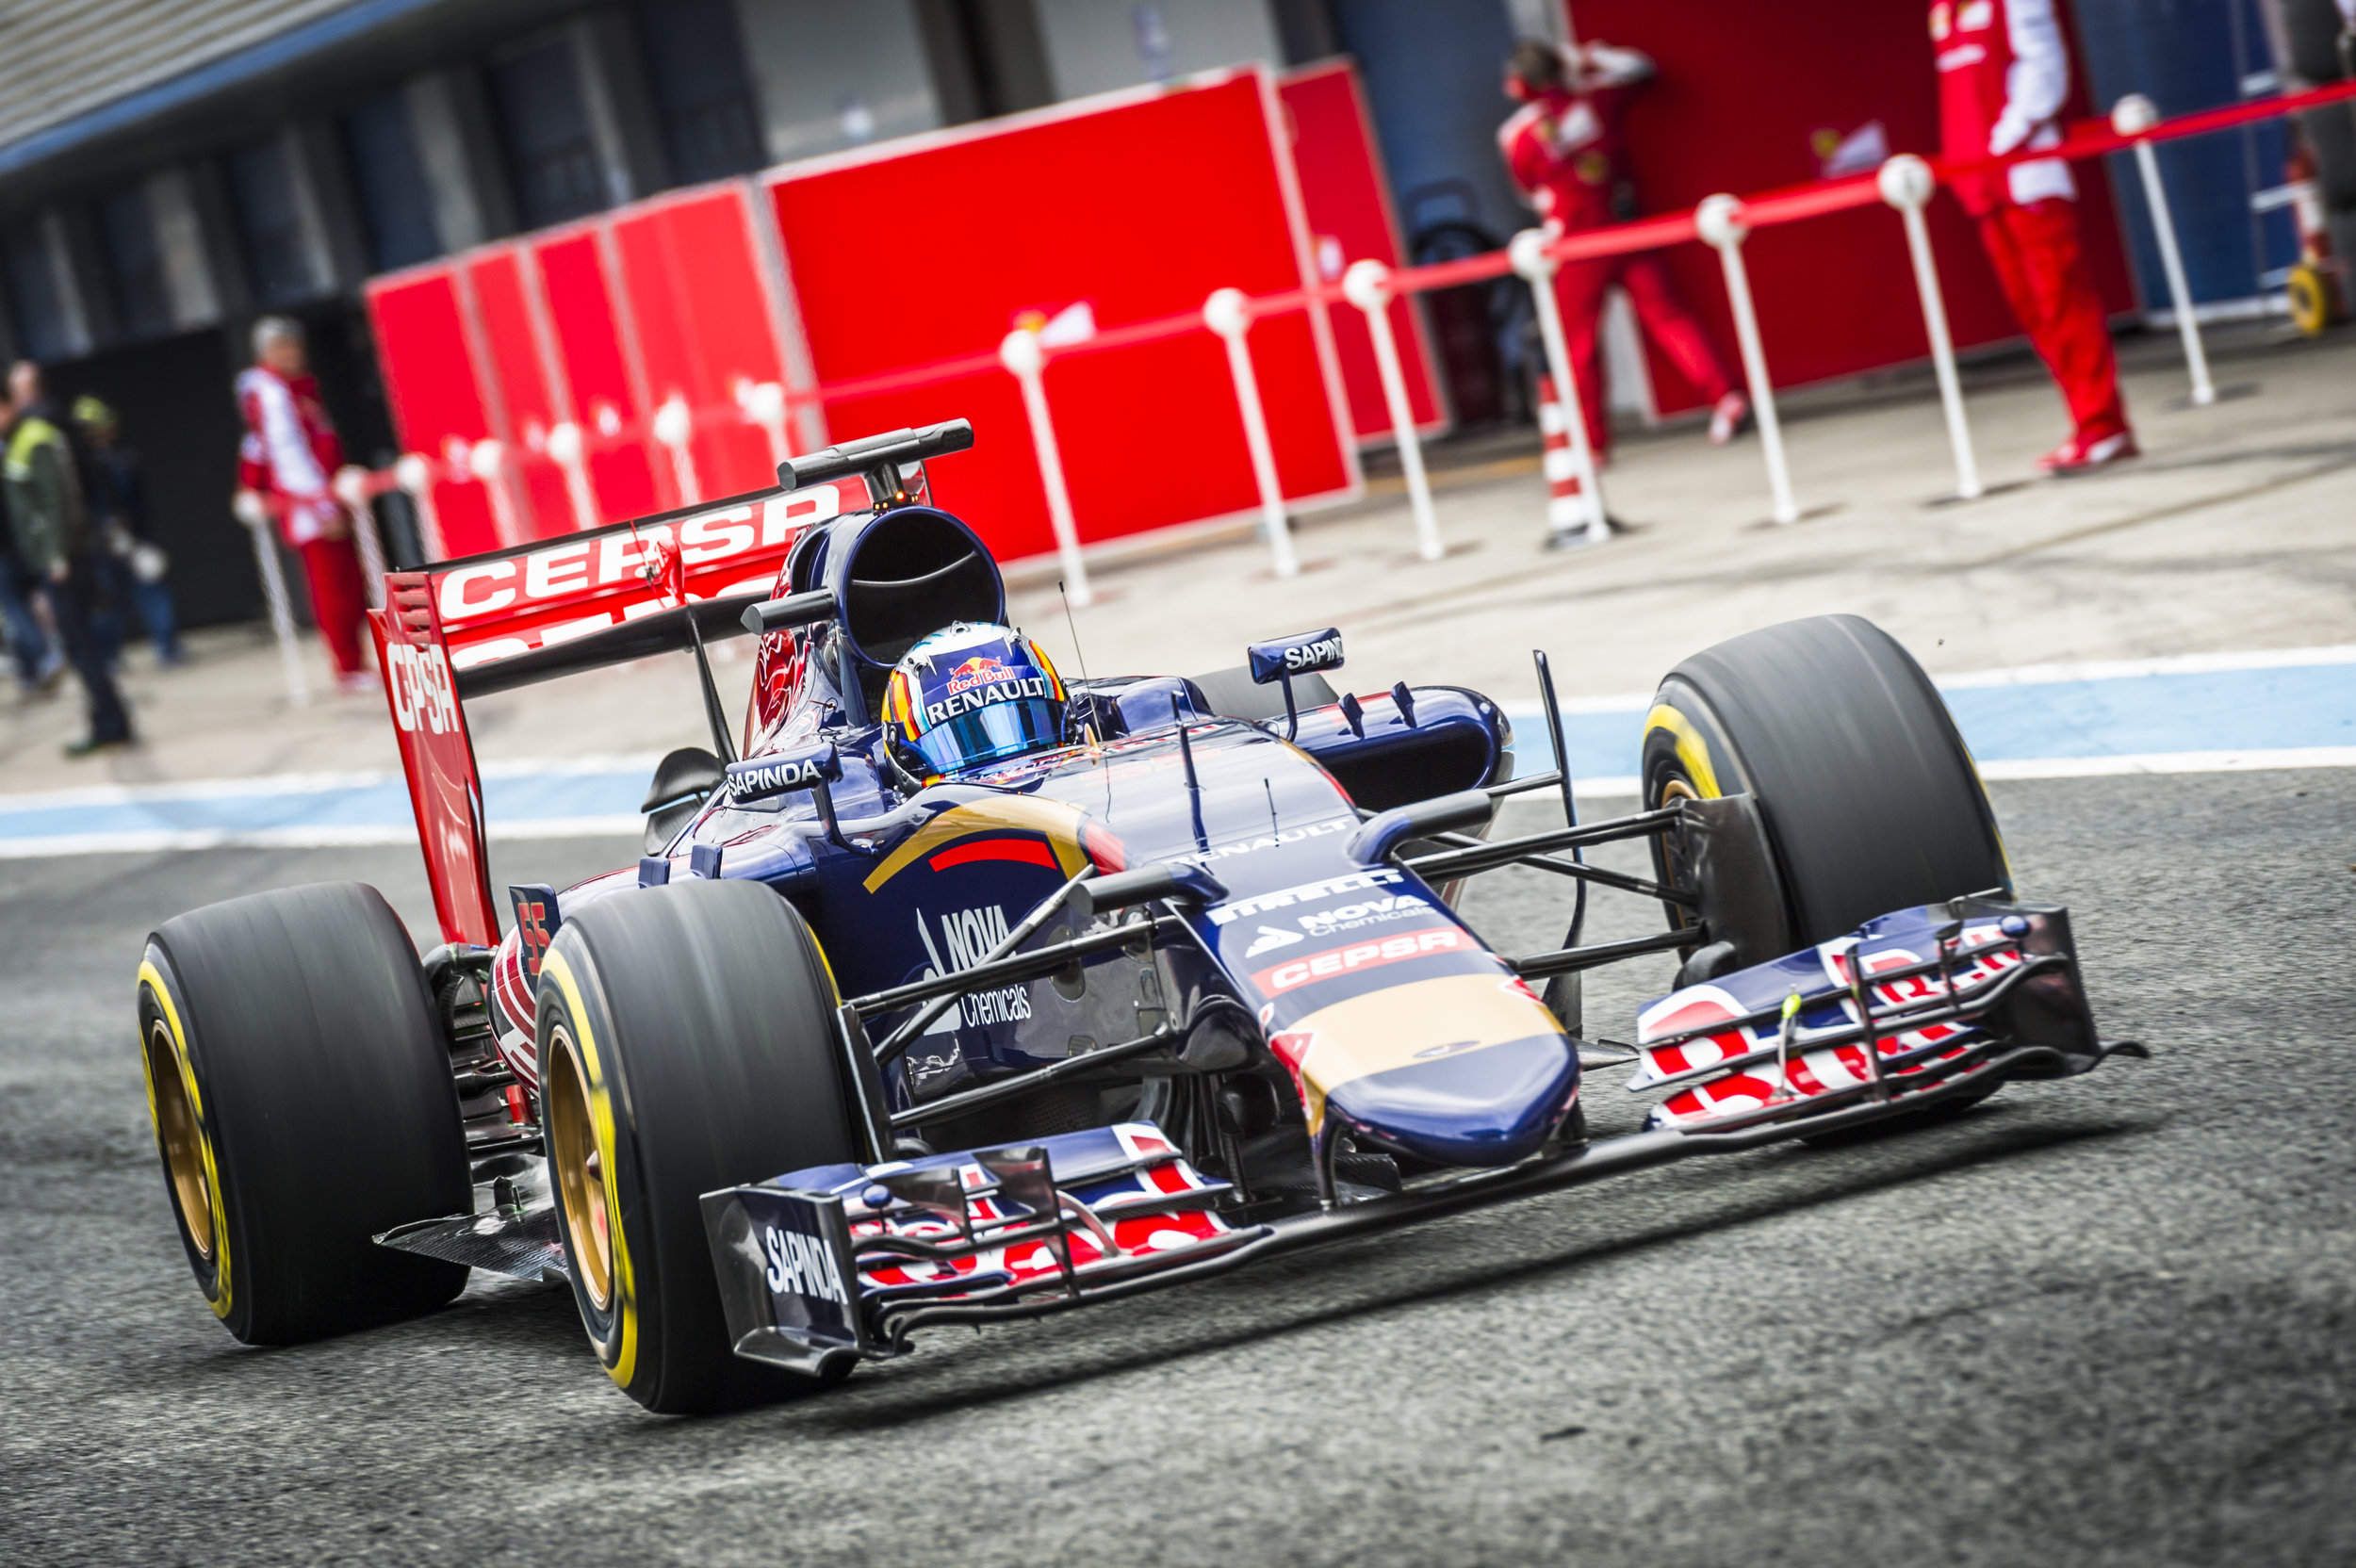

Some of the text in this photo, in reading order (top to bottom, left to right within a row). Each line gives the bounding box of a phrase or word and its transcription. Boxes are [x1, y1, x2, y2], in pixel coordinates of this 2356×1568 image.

[440, 484, 840, 620] CEPSA
[926, 677, 1046, 725] RENAULT
[947, 666, 1015, 695] Red Bull
[727, 759, 823, 797] SAPINDA
[1161, 818, 1350, 866] RENAULT
[1297, 894, 1430, 930] NOVA
[1308, 906, 1437, 938] Chemicals
[518, 902, 552, 976] 55
[1271, 931, 1458, 989] CEPSA
[960, 984, 1032, 1028] Chemicals
[765, 1225, 848, 1305] SAPINDA
